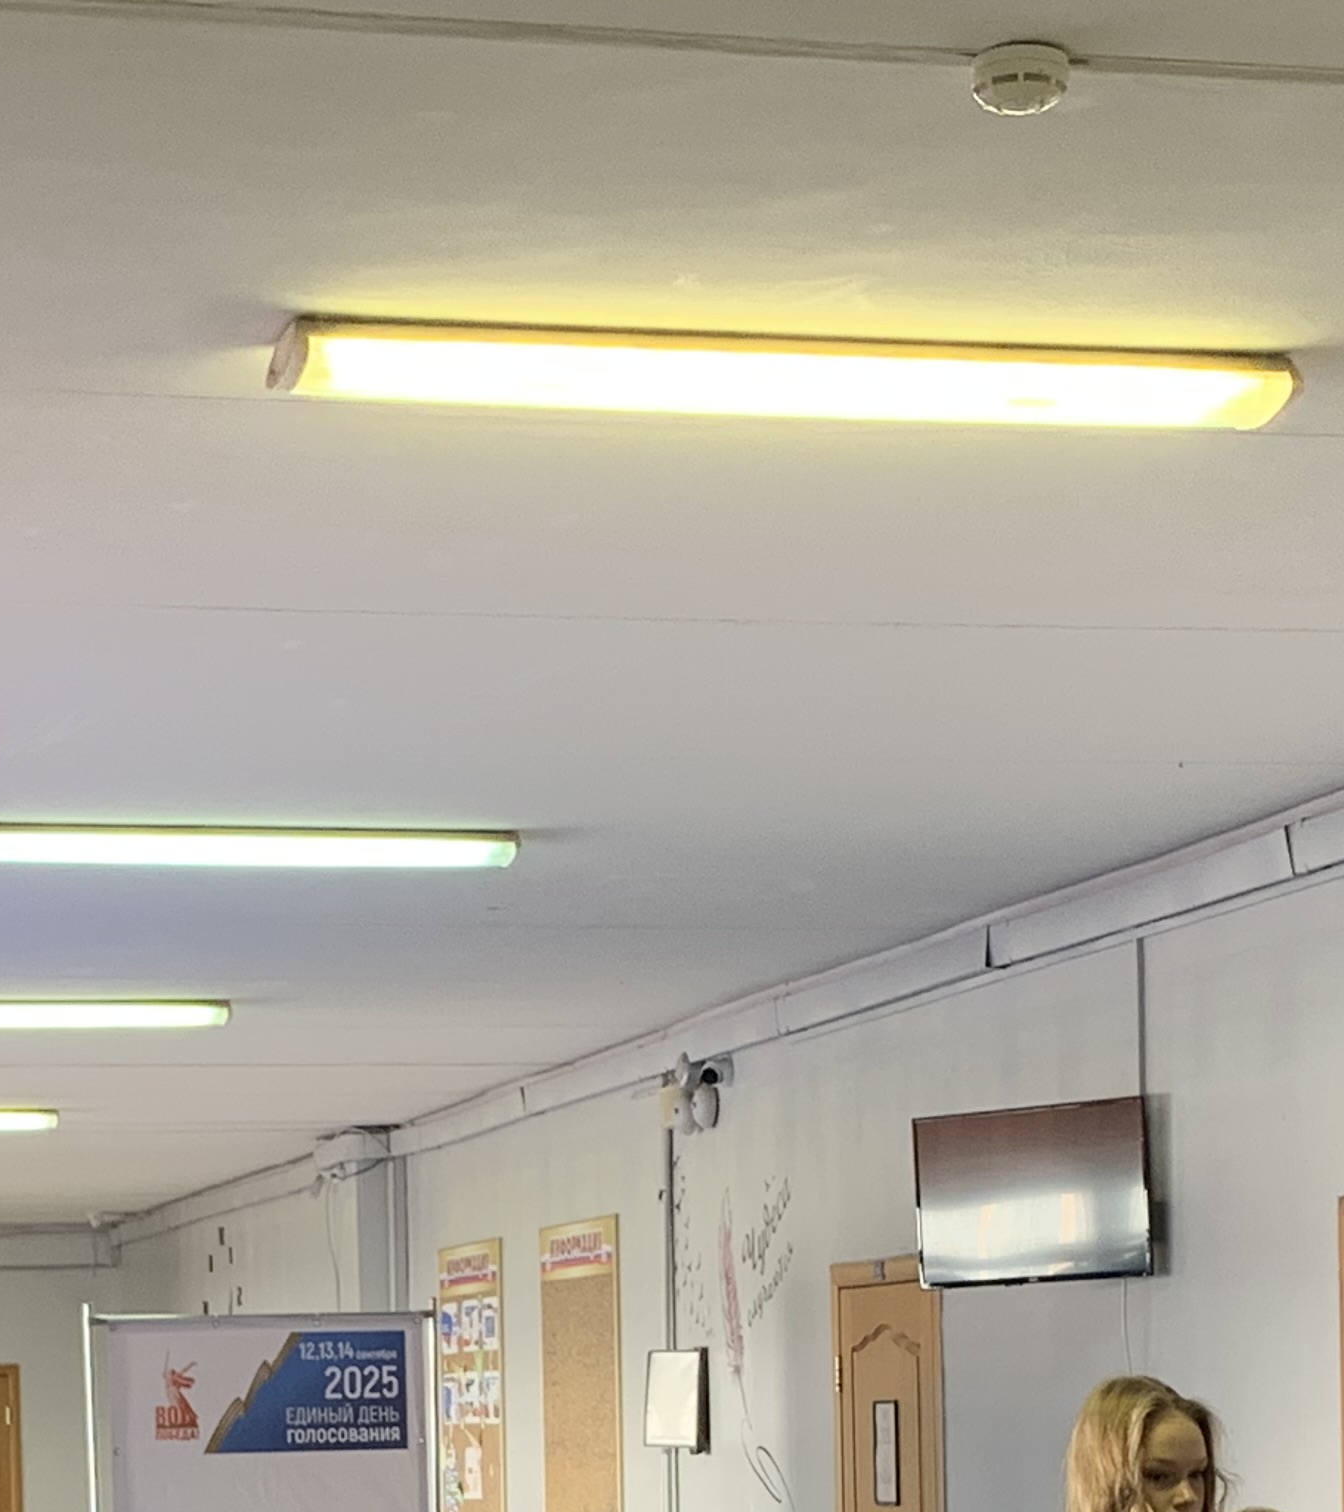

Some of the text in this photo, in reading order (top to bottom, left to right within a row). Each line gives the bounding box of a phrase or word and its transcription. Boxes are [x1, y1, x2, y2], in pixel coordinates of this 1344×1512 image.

[325, 1365, 400, 1399] 2025
[286, 1402, 400, 1426] ЕДИНЫЙ ДЕНЬ
[287, 1426, 401, 1444] голосования
